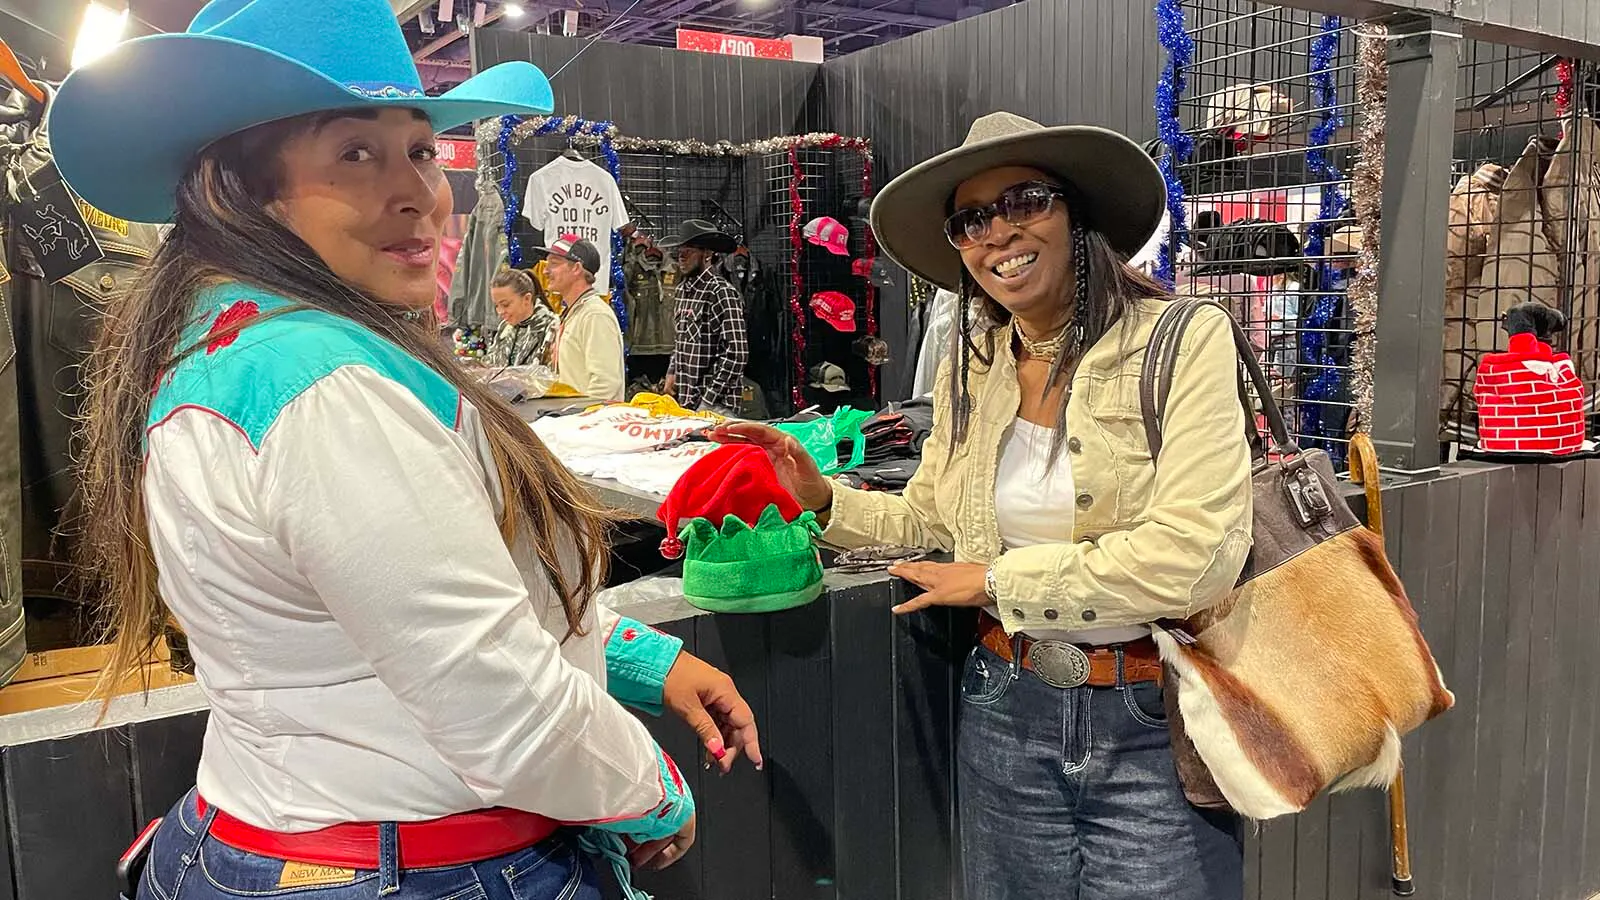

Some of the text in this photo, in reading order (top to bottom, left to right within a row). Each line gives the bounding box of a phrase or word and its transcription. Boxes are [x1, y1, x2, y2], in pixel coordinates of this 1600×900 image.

[434, 143, 455, 160] 500
[549, 183, 609, 215] COWBOYS
[563, 207, 592, 223] DO IT
[290, 868, 318, 879] NEW
